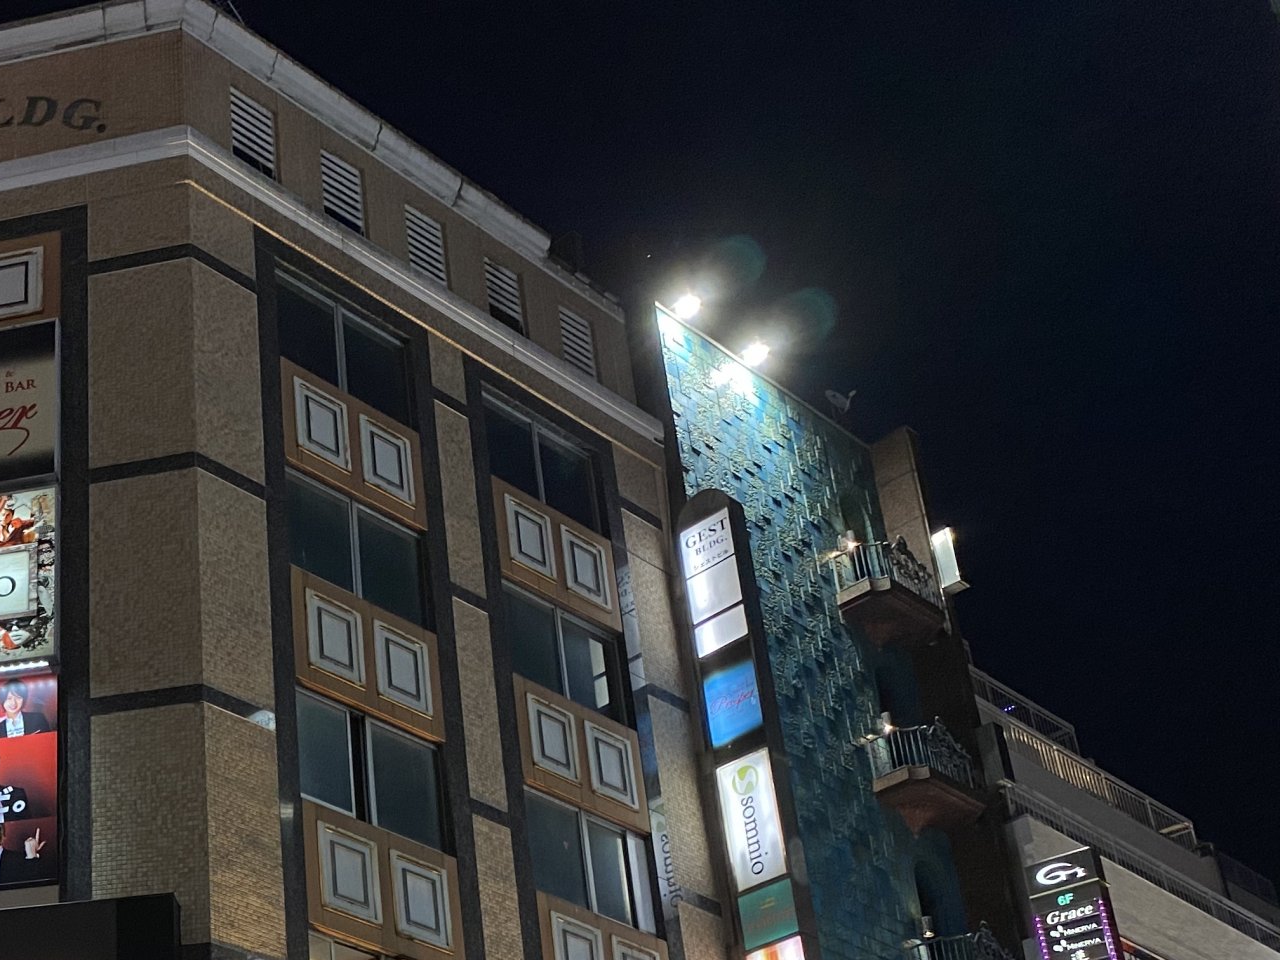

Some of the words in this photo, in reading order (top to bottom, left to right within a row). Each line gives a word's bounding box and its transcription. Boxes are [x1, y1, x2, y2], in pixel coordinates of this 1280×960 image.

[4, 378, 37, 394] BAR
[685, 517, 727, 549] GEST
[695, 535, 728, 556] BLDG.
[740, 796, 769, 876] somnio
[1057, 892, 1074, 906] 6F
[1046, 905, 1094, 925] Grace
